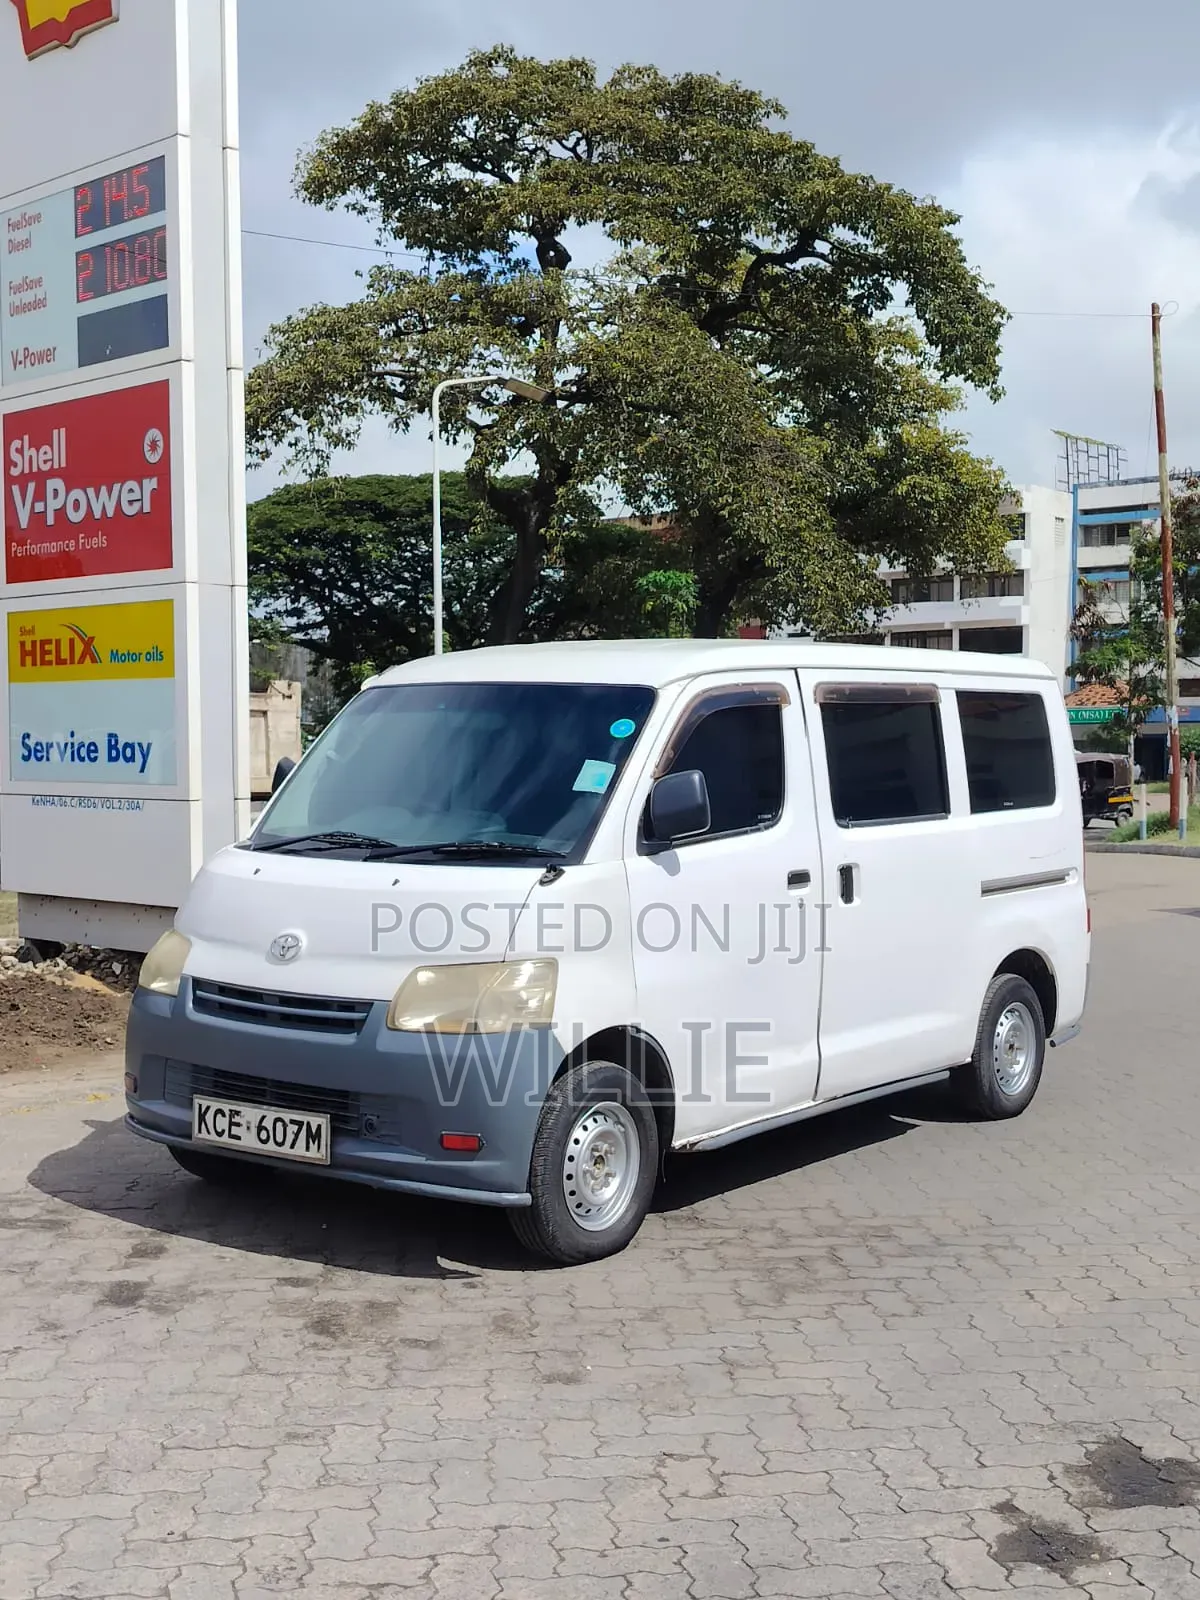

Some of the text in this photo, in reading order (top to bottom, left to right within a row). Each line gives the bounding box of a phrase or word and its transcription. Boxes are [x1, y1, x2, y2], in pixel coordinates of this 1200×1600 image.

[7, 211, 43, 233] FuelSave
[7, 231, 32, 255] Diesel
[8, 275, 44, 297] FuelSave
[8, 291, 48, 318] Unleaded
[10, 346, 58, 372] V-Power
[9, 427, 68, 478] Shell
[11, 476, 159, 531] V-Power
[11, 530, 108, 558] Performance Fuels
[19, 625, 36, 637] Shell
[19, 635, 165, 668] HELIX Motor oils
[21, 730, 153, 774] Service Bay
[197, 1102, 323, 1153] KCE 607M
